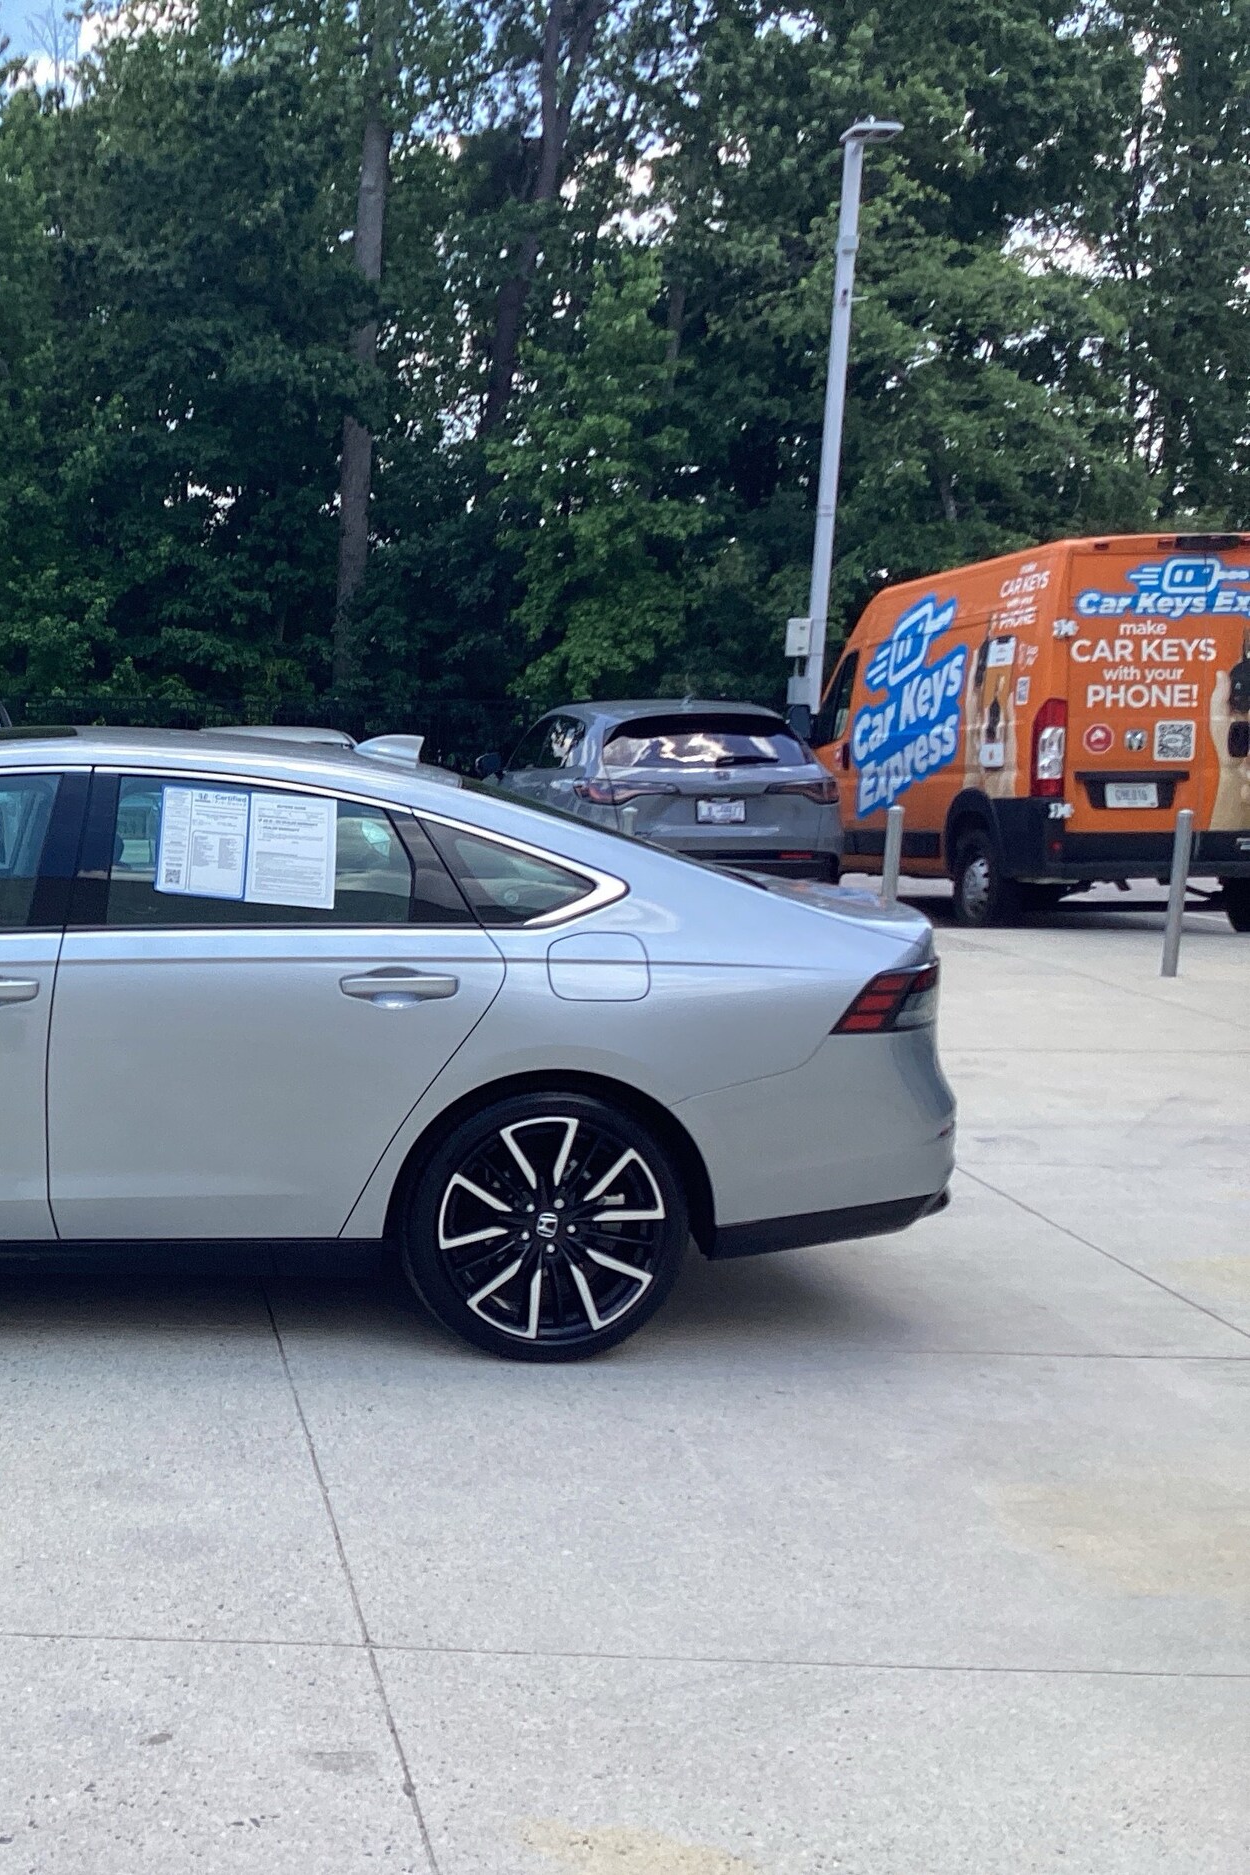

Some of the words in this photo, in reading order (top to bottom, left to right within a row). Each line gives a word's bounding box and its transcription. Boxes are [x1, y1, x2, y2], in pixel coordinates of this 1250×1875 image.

[1023, 570, 1050, 592] KEYS
[1078, 593, 1131, 614] Car
[1136, 592, 1206, 617] Keys
[1213, 591, 1250, 616] Ex
[1119, 620, 1167, 635] make
[1070, 638, 1134, 663] CAR
[1141, 638, 1217, 662] KEYS
[1102, 665, 1141, 681] with
[1145, 667, 1184, 683] your
[853, 701, 897, 761] Car
[899, 653, 965, 732] Keys
[1086, 684, 1199, 708] PHONE!
[858, 714, 958, 813] Express
